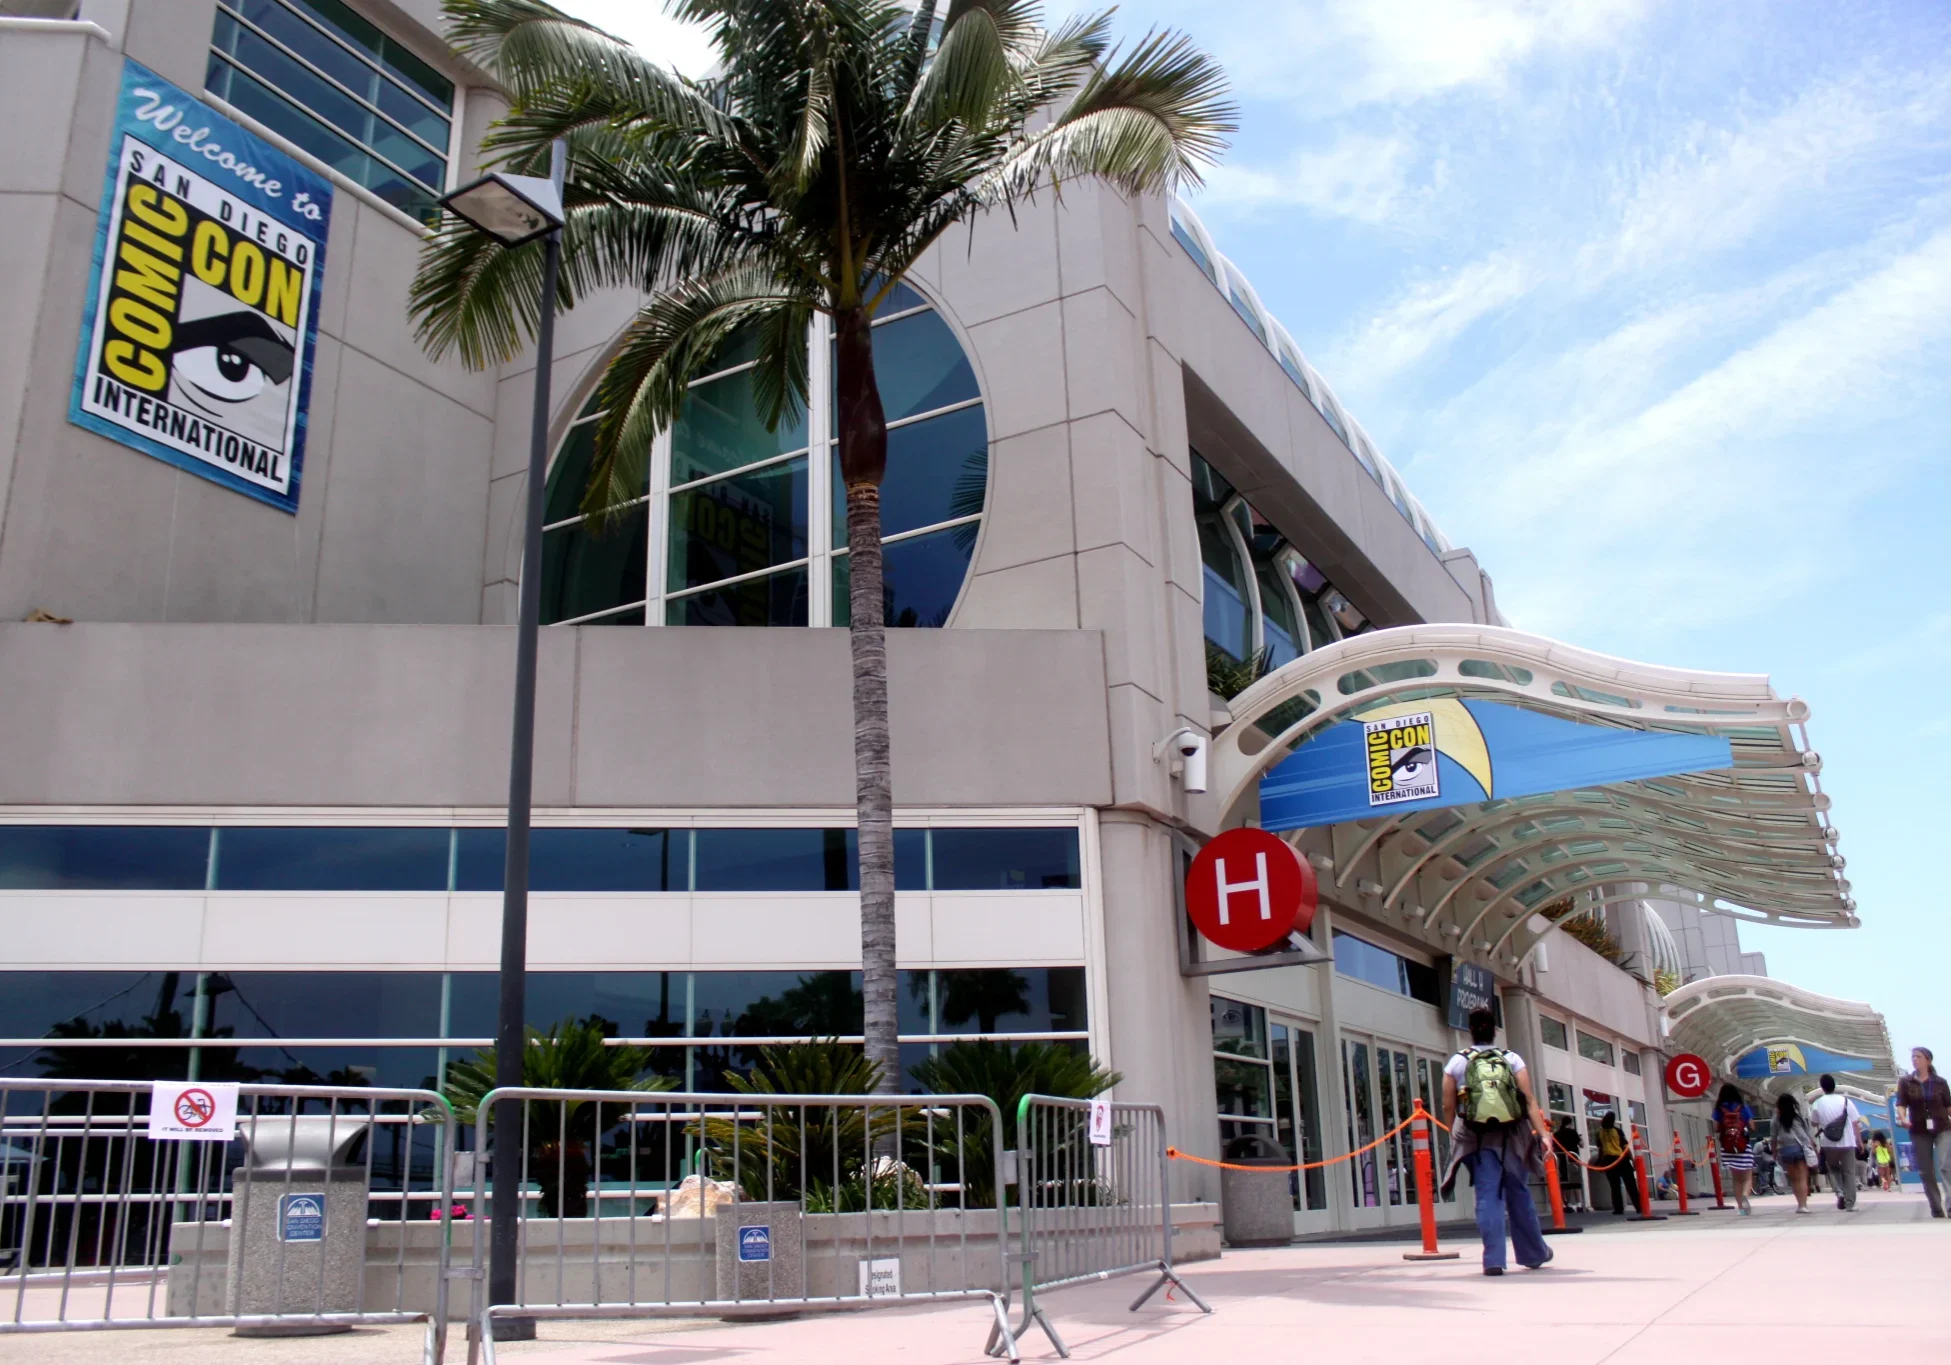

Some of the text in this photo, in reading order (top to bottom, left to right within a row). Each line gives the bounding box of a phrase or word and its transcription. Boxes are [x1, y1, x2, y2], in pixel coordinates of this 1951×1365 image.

[132, 86, 323, 221] Welcome to
[129, 149, 309, 266] SAN DIEGO
[104, 183, 189, 392] COMIC
[191, 219, 305, 329] CON
[92, 375, 284, 484] INTERNATIONAL
[1366, 715, 1430, 733] SAN DIEGO
[1368, 731, 1393, 792] COMIC
[1389, 723, 1431, 750] CON
[1371, 785, 1437, 803] INTERNATIONAL
[1215, 851, 1272, 926] H
[1675, 1062, 1701, 1088] G
